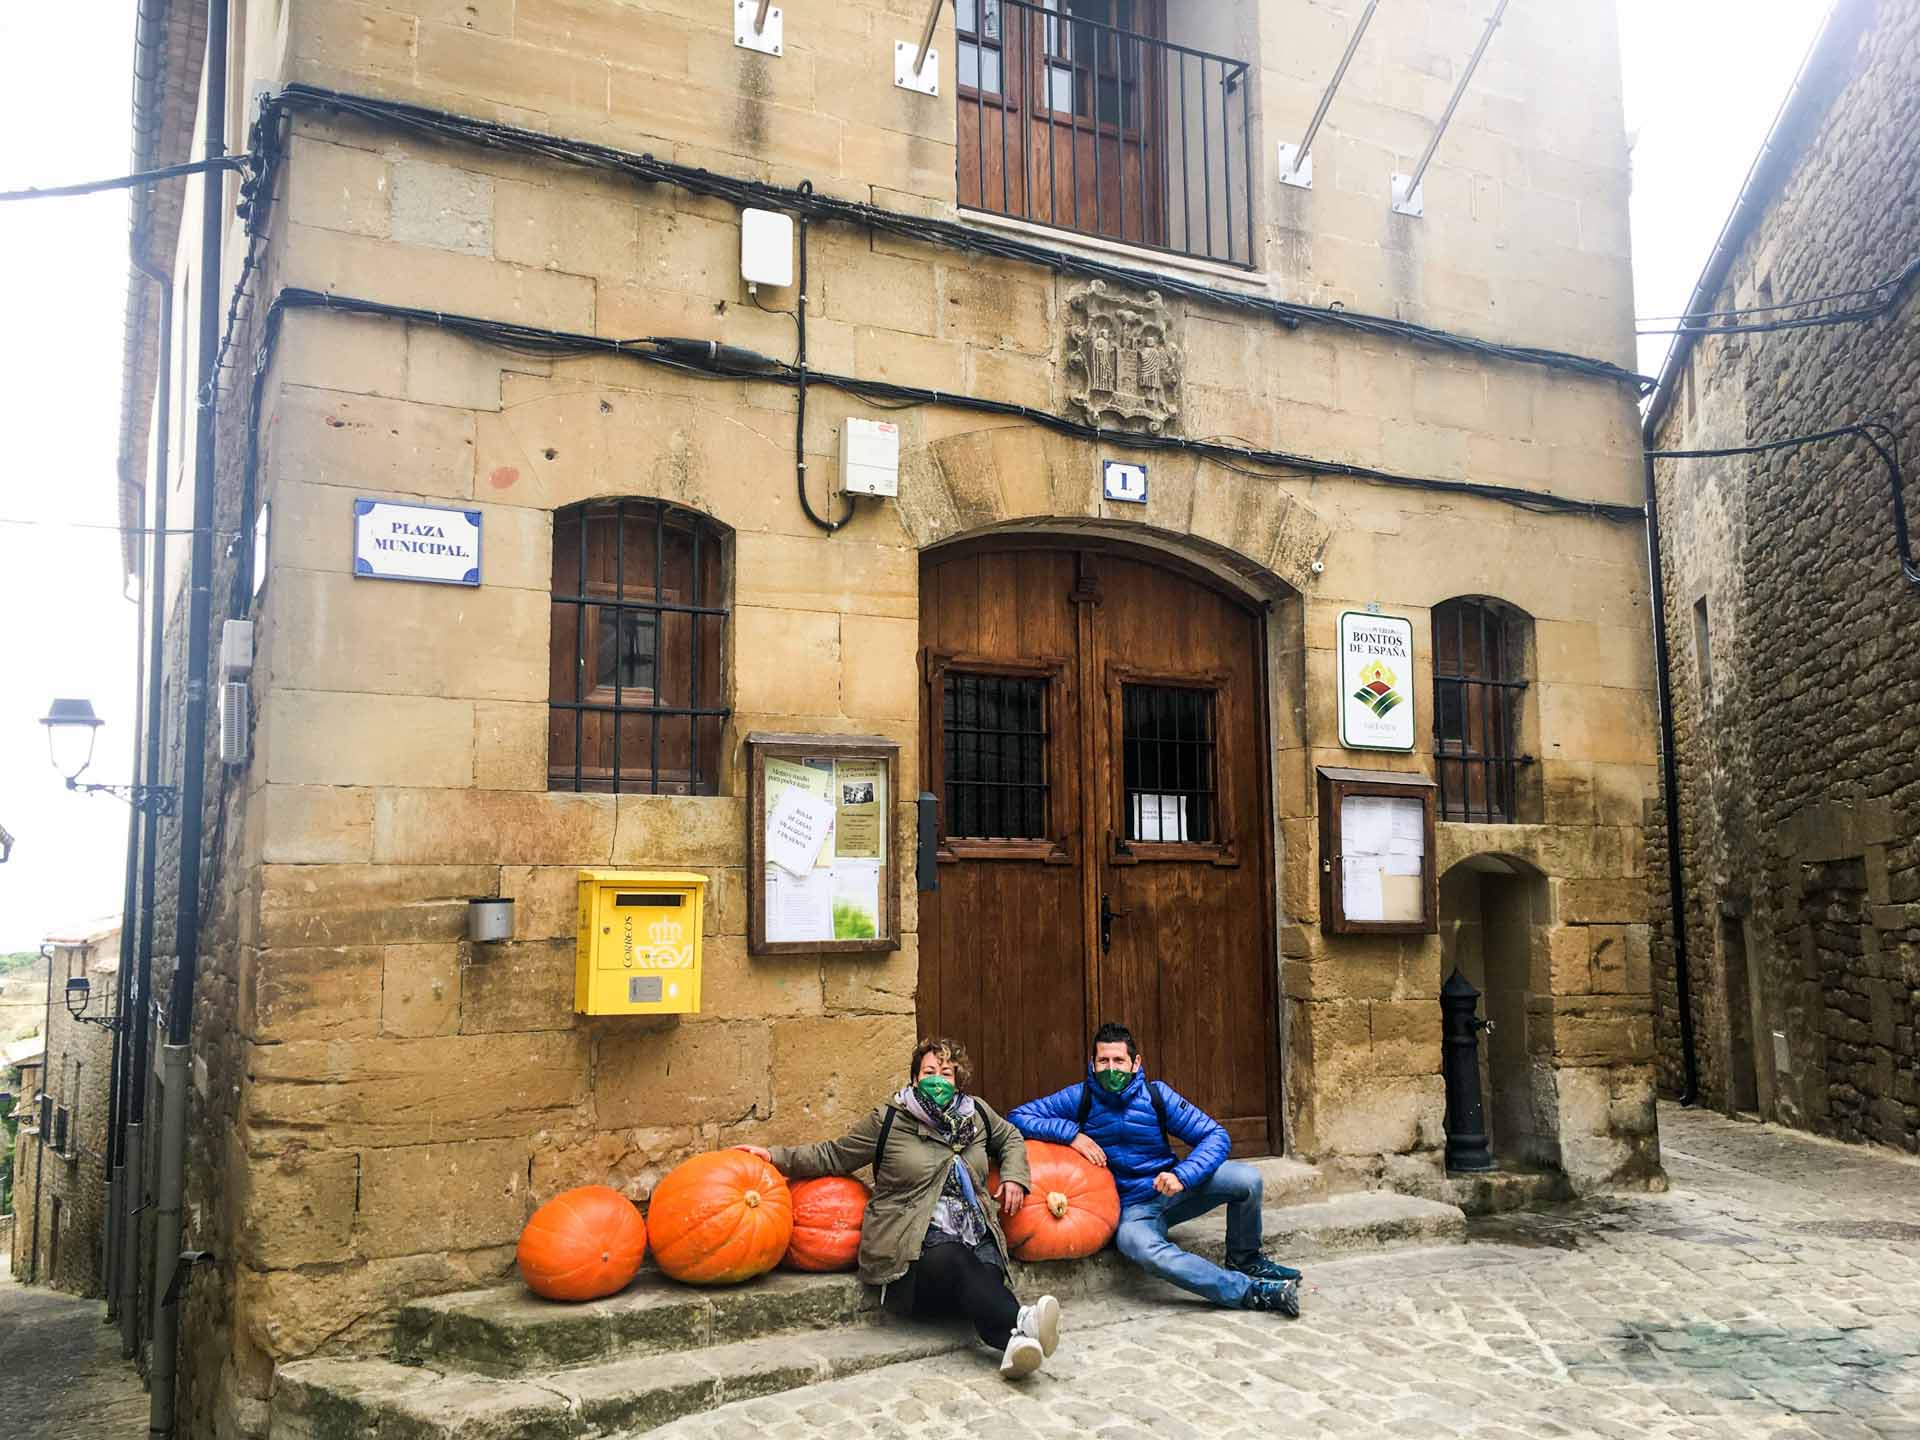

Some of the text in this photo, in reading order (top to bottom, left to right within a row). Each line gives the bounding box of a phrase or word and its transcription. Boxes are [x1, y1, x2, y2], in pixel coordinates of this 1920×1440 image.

[391, 522, 445, 538] PLAZA
[375, 538, 470, 558] MUNICIPAL.
[1353, 632, 1402, 646] BONITOS
[1350, 643, 1406, 657] DE ESPAÑA
[624, 915, 633, 968] CORREOS
